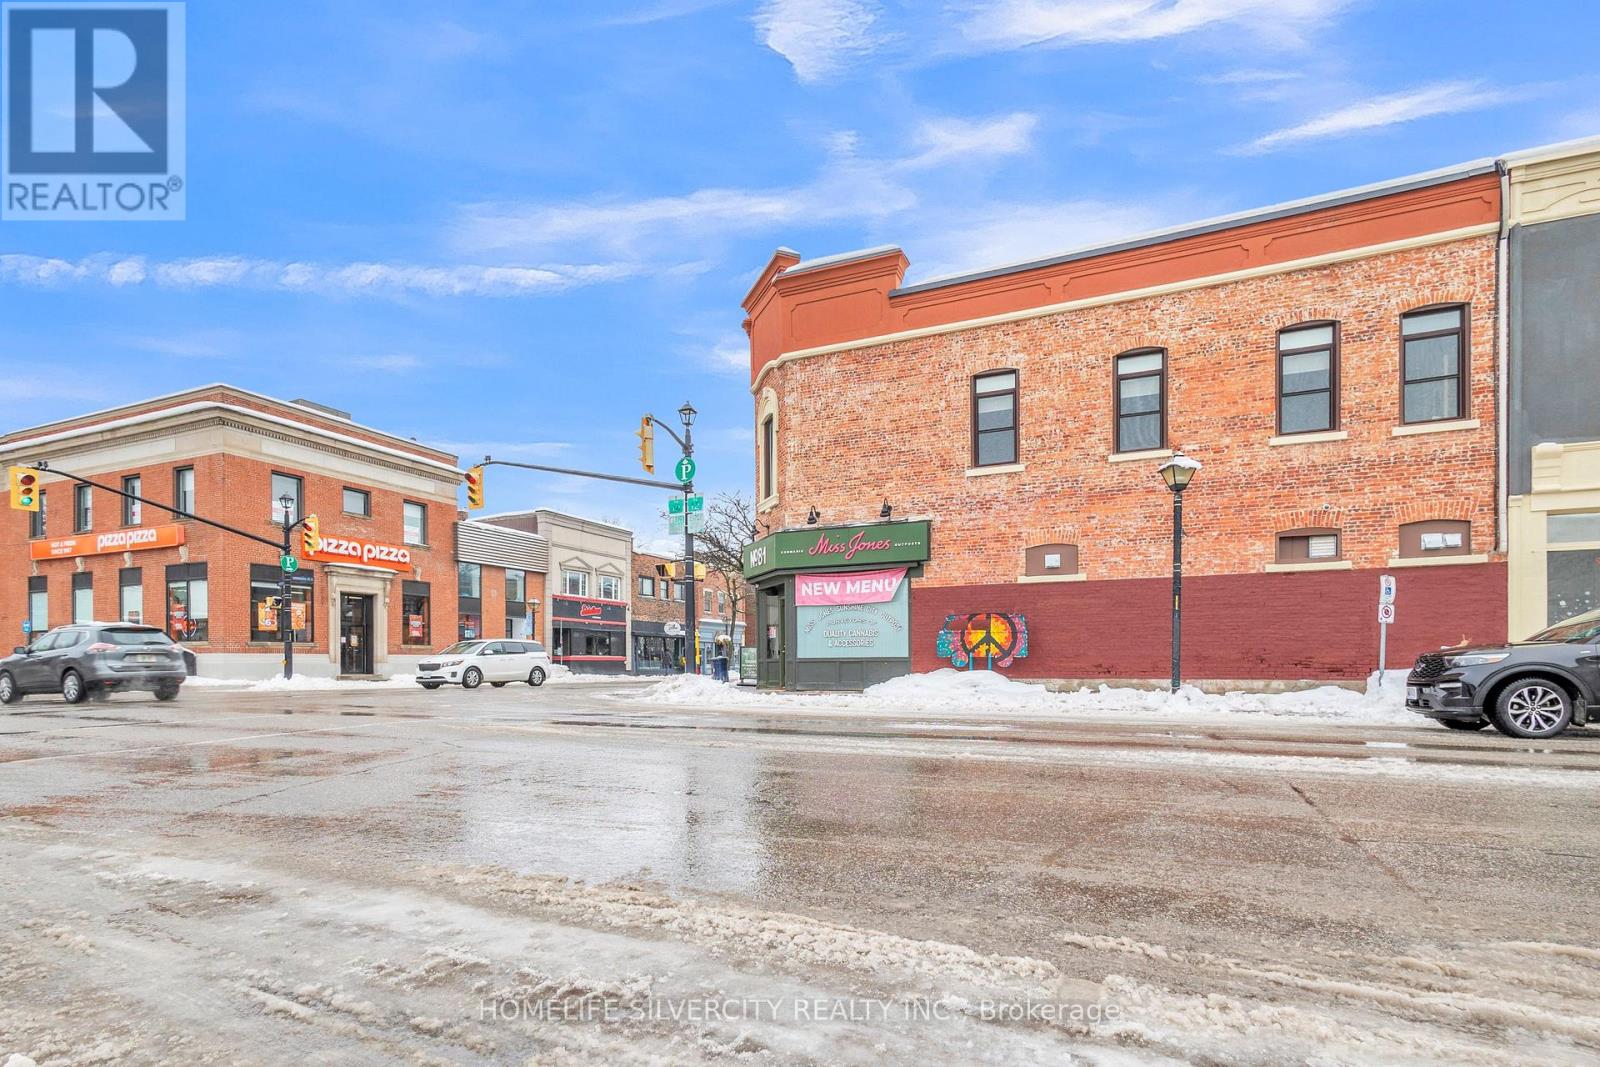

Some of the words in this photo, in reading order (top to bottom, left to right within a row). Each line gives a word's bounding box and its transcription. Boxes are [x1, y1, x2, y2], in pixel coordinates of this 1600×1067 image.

[363, 543, 411, 563] pizza
[808, 532, 846, 556] Miss
[845, 530, 891, 560] Jones
[801, 581, 841, 596] NEW
[846, 576, 897, 594] MENU
